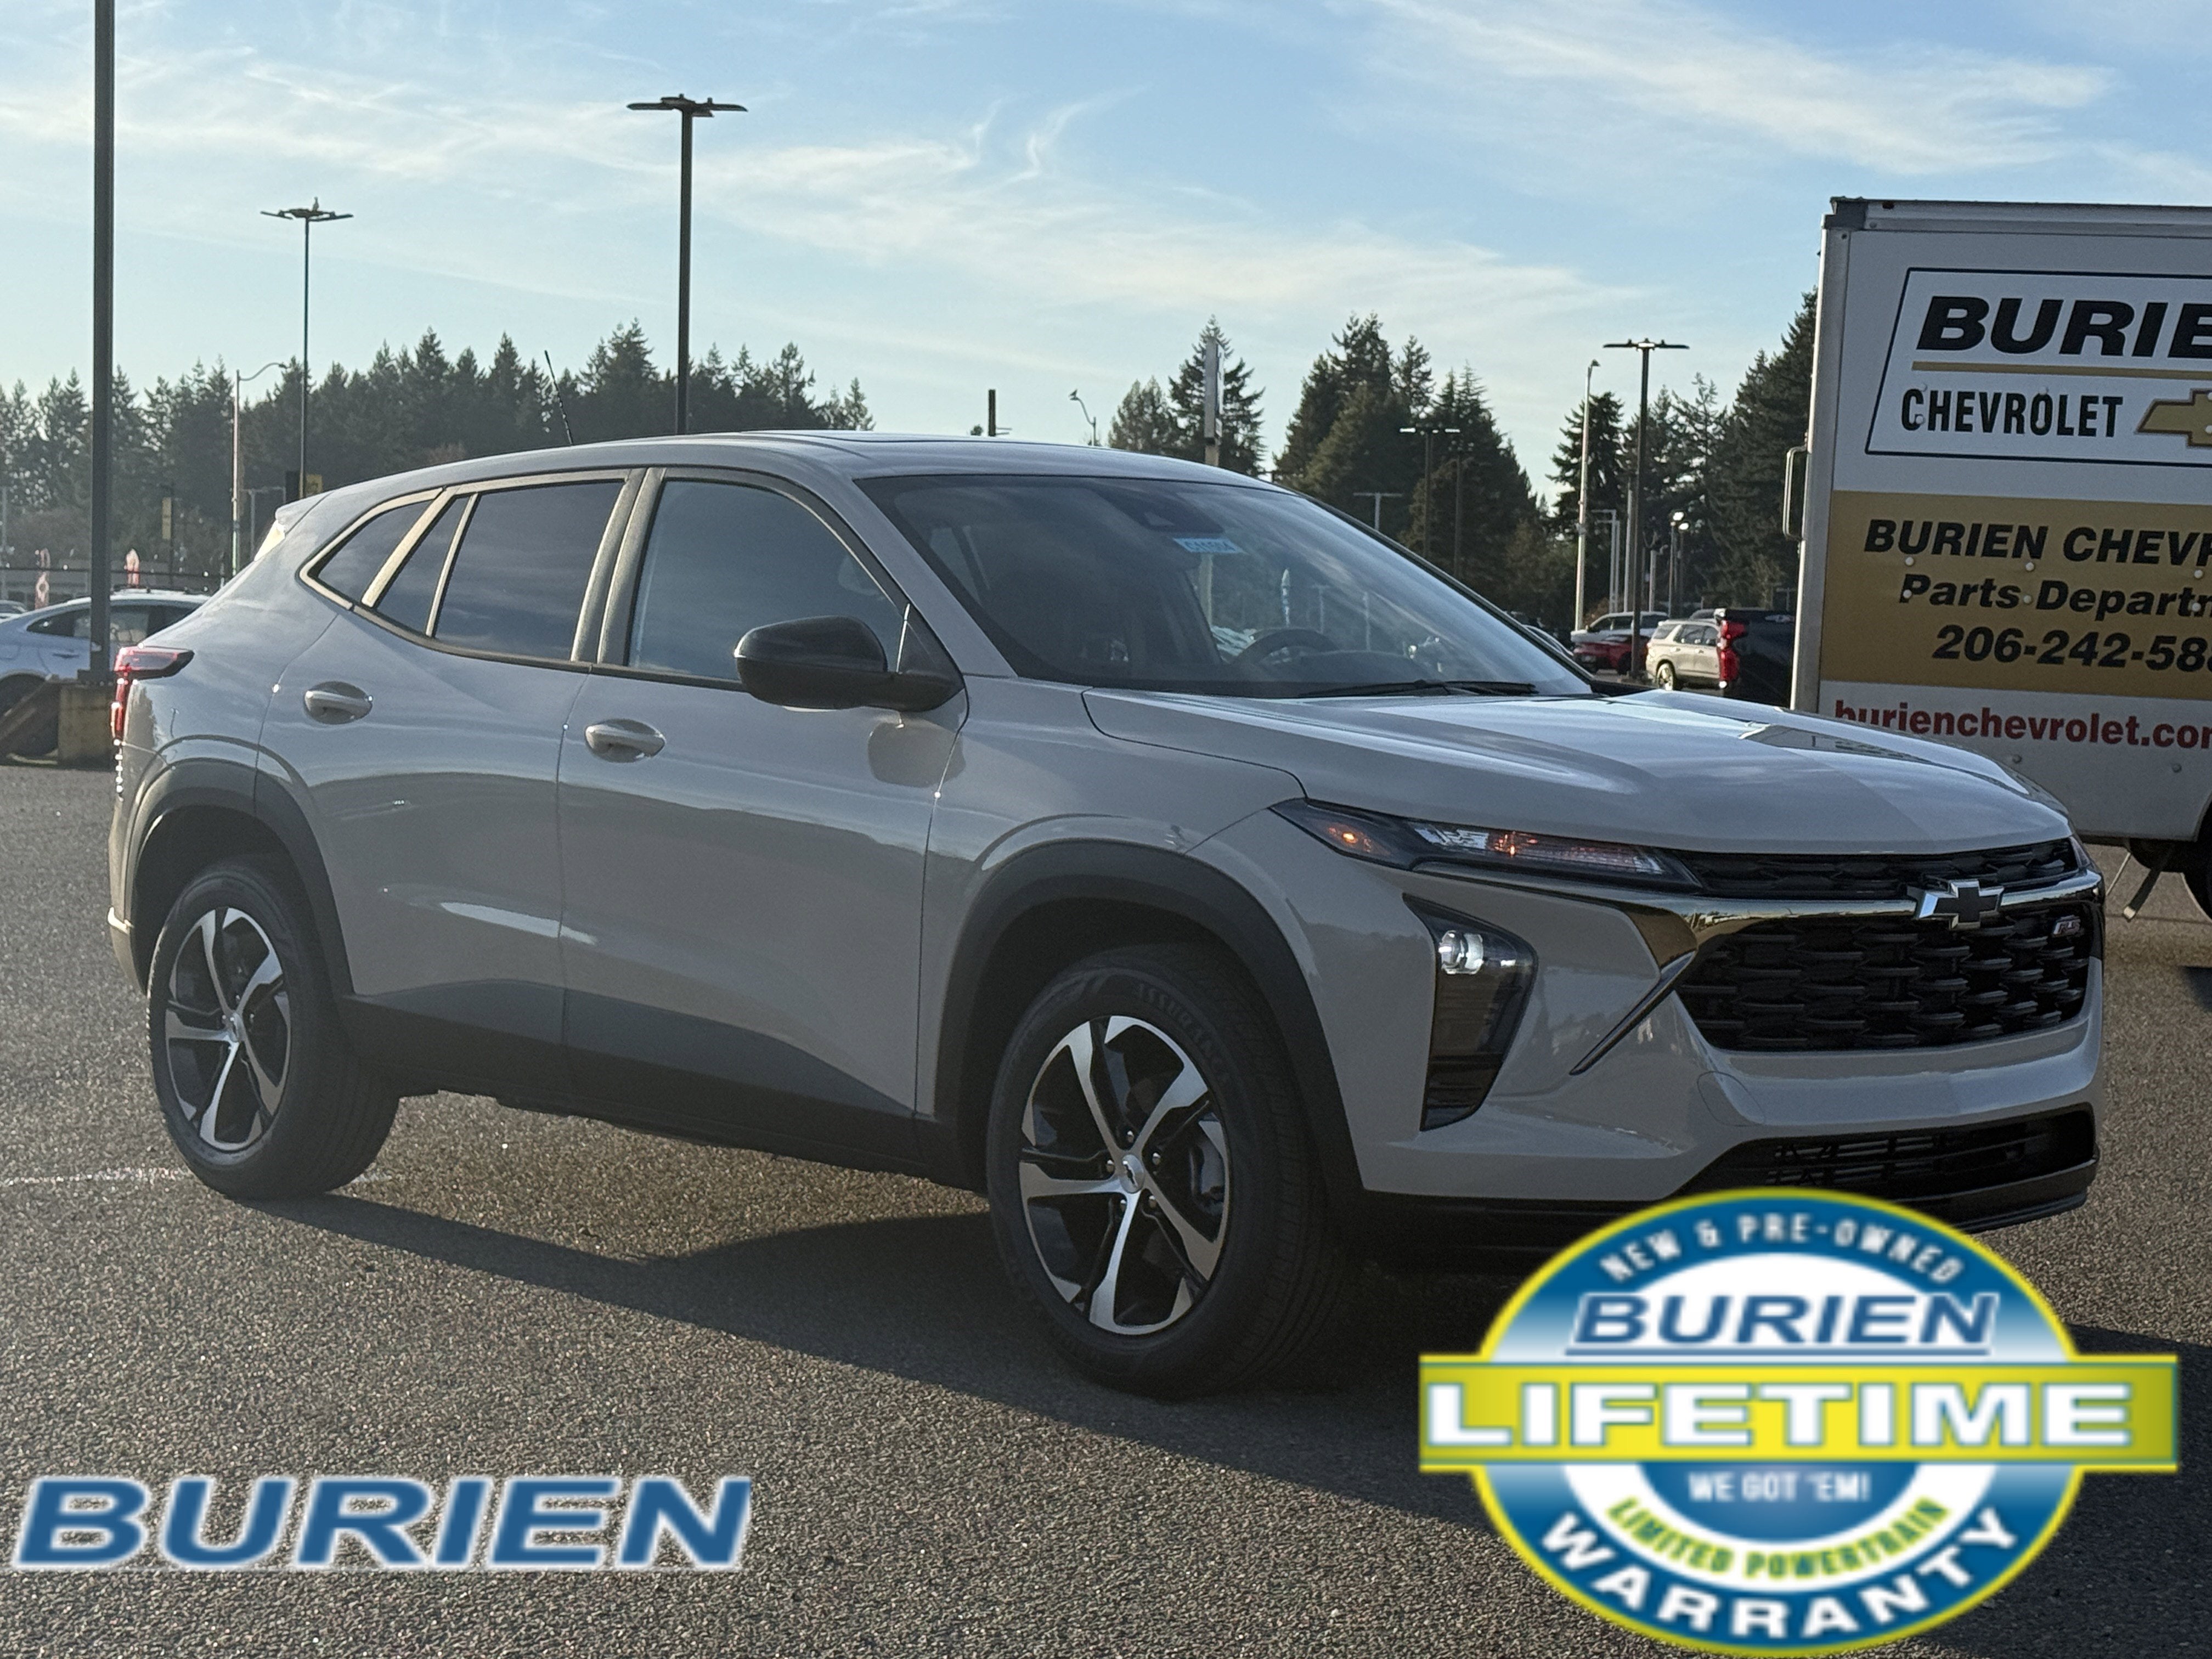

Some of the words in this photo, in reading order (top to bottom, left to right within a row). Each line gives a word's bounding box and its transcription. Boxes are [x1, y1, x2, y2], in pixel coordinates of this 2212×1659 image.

[1901, 387, 2124, 438] CHEVROLET
[1864, 519, 2049, 560] BURIEN
[1899, 573, 2022, 610] Parts
[1932, 624, 2212, 673] 206-242-58
